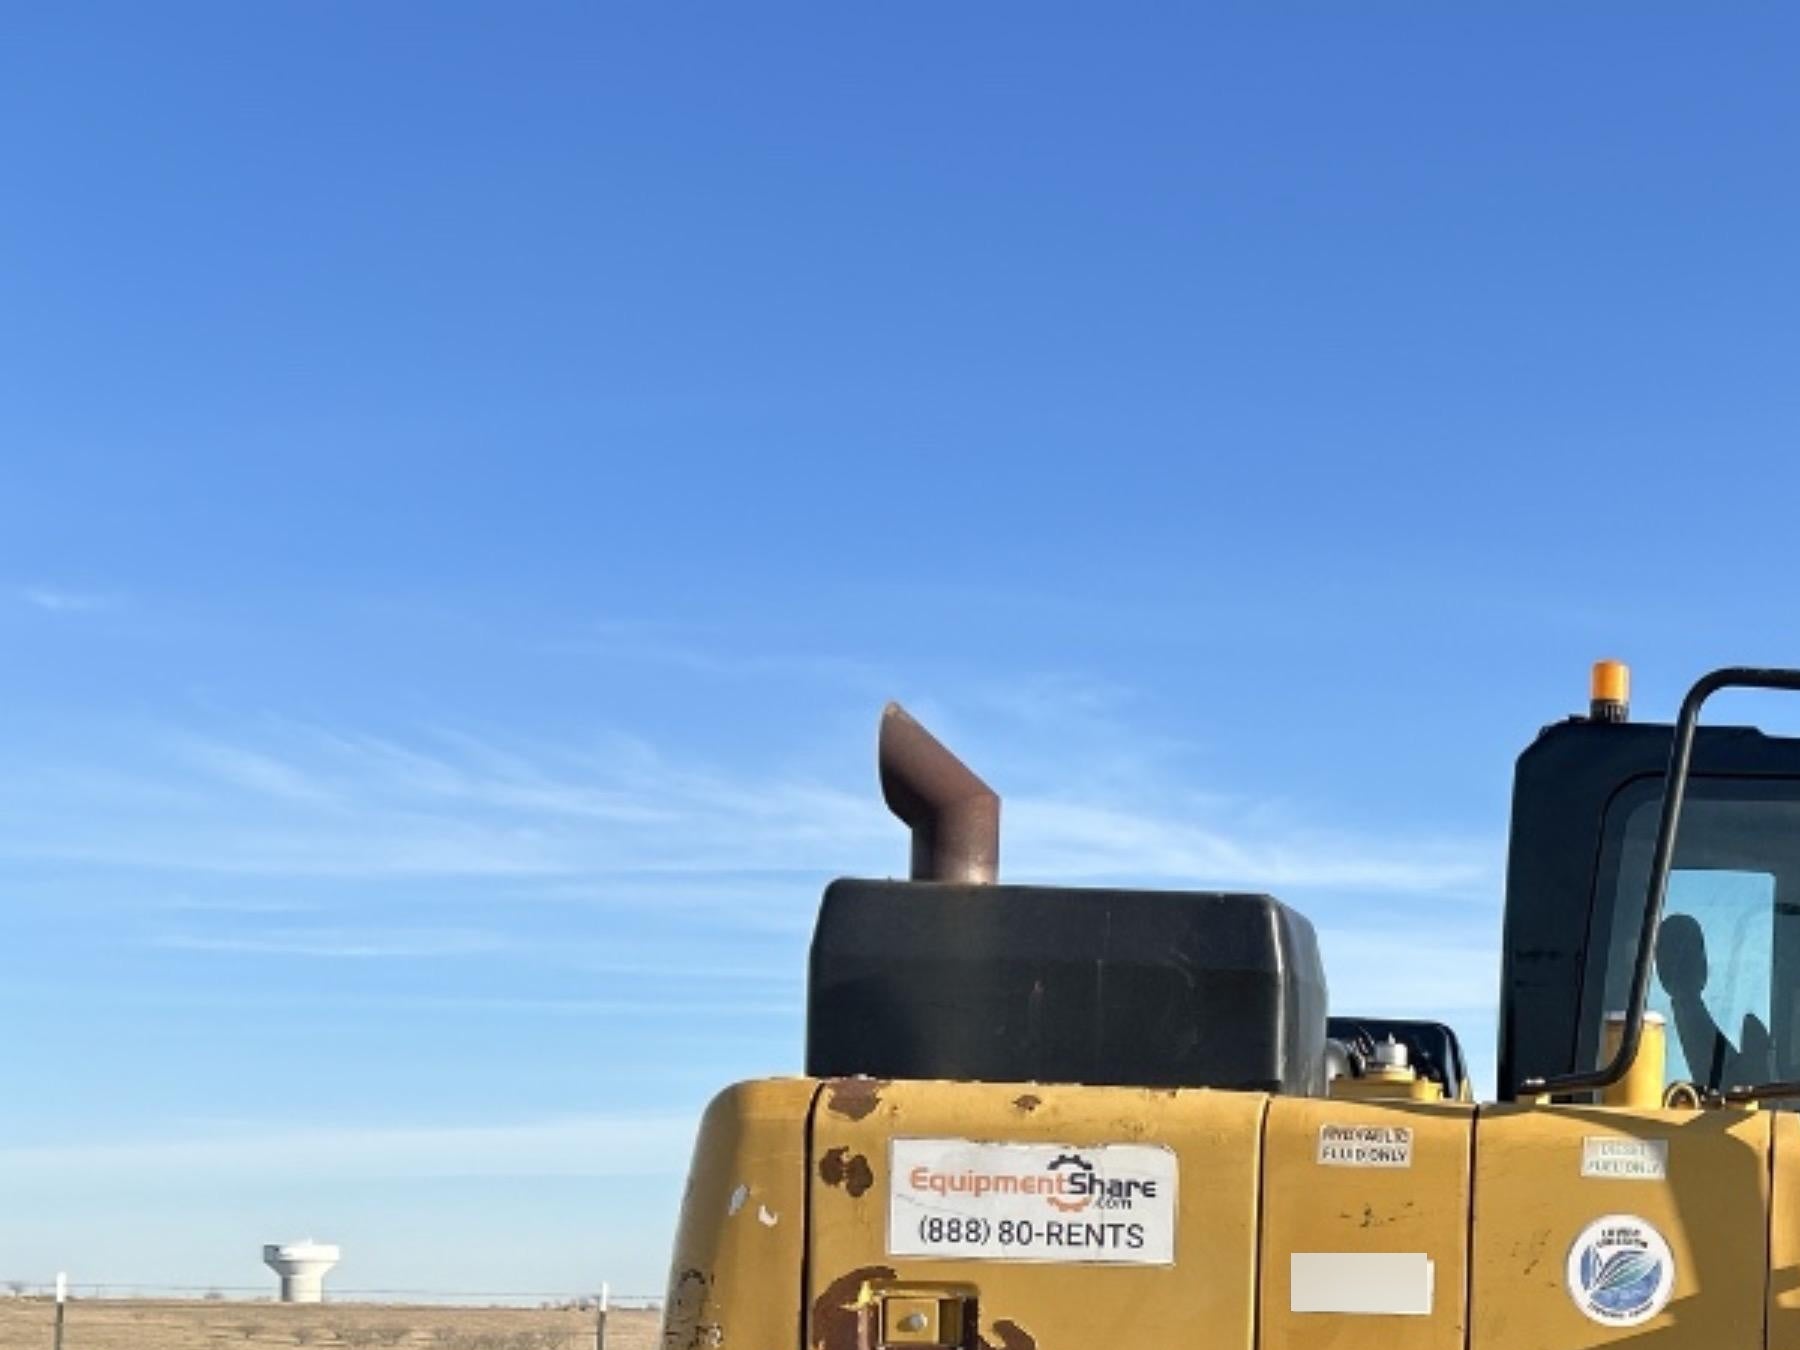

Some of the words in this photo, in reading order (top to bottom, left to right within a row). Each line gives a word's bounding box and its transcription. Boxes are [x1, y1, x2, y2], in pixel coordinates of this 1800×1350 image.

[1323, 1146, 1365, 1161] FLUID
[1369, 1147, 1408, 1162] ONLY
[910, 1166, 1157, 1198] EquipmentShare
[919, 1215, 991, 1246] (888)
[998, 1220, 1145, 1249] 80-RENTS
